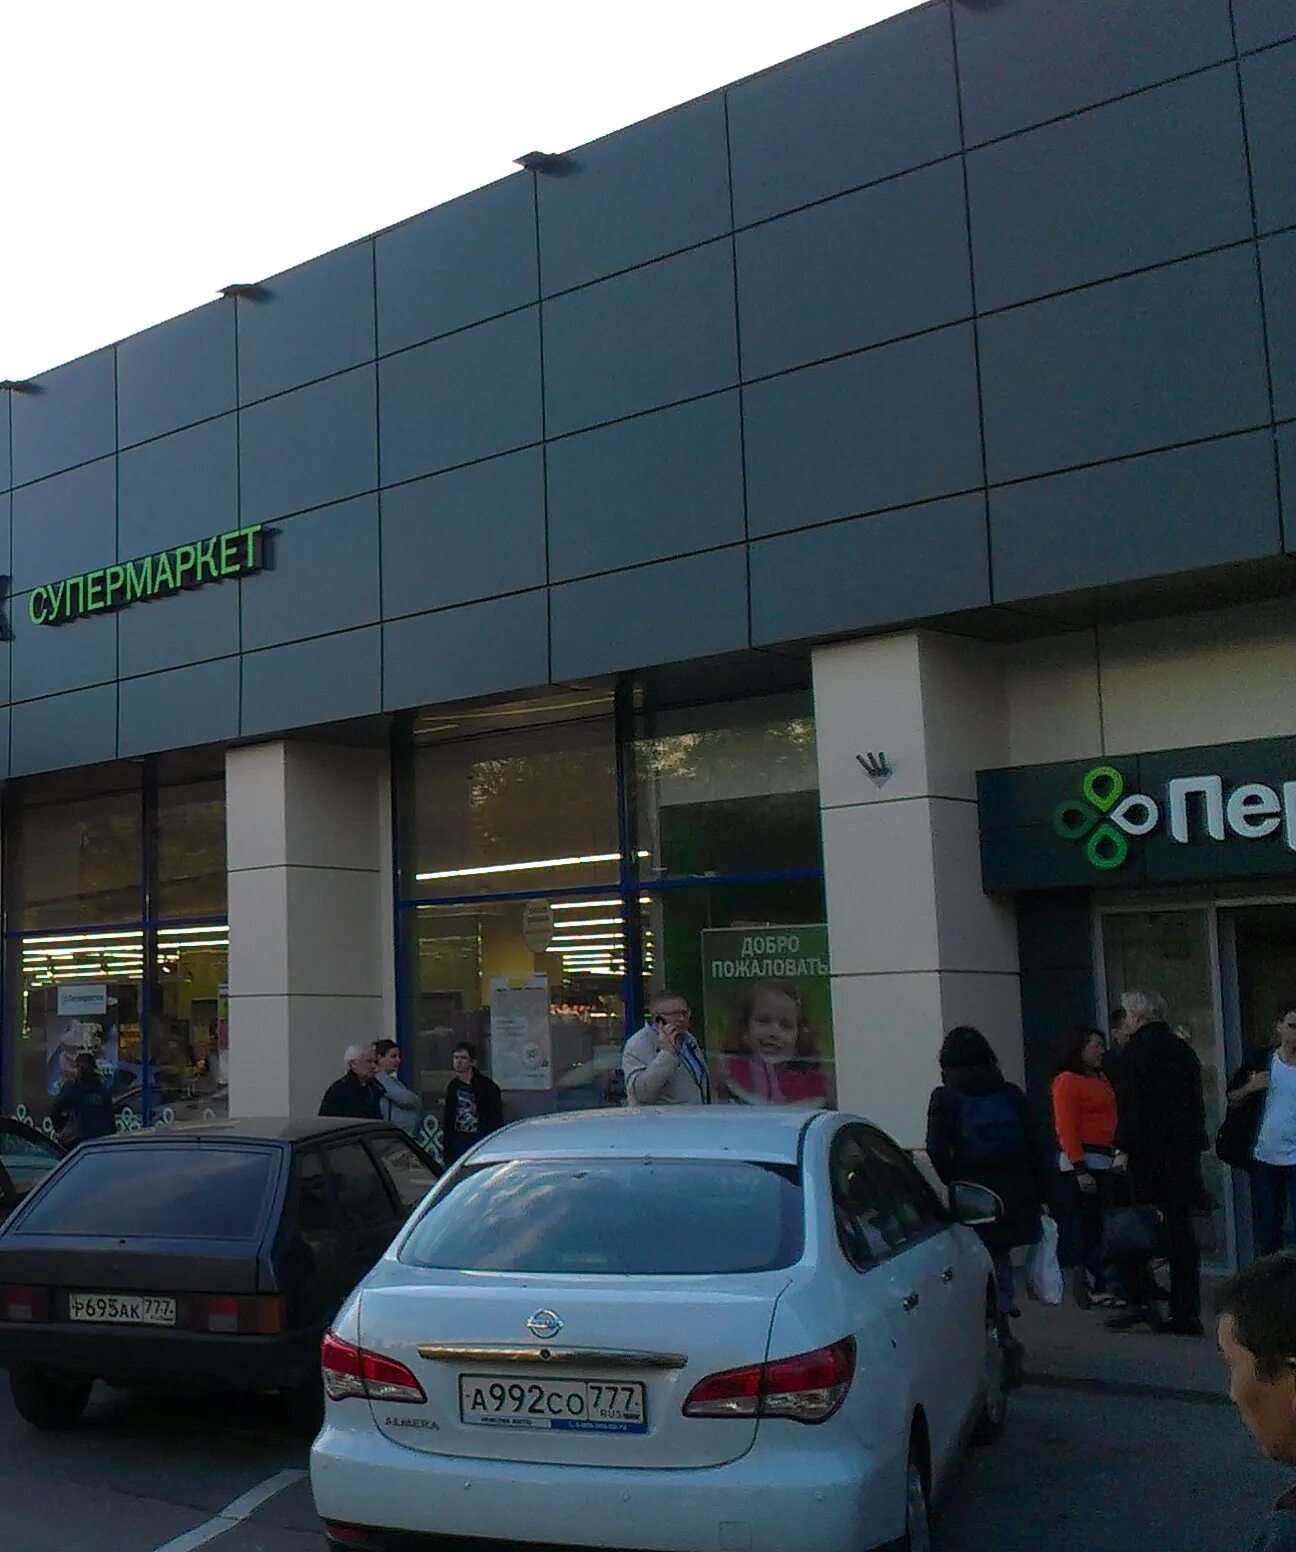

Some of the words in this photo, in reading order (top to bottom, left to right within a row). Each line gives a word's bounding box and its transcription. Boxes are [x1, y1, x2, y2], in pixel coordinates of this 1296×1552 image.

[28, 523, 264, 627] СУПЕРМАРКЕТ
[741, 935, 800, 958] ДОБРО
[711, 957, 830, 978] ПОЖАЛОВАТЬ
[470, 1382, 585, 1416] А992СО
[589, 1385, 635, 1412] 777
